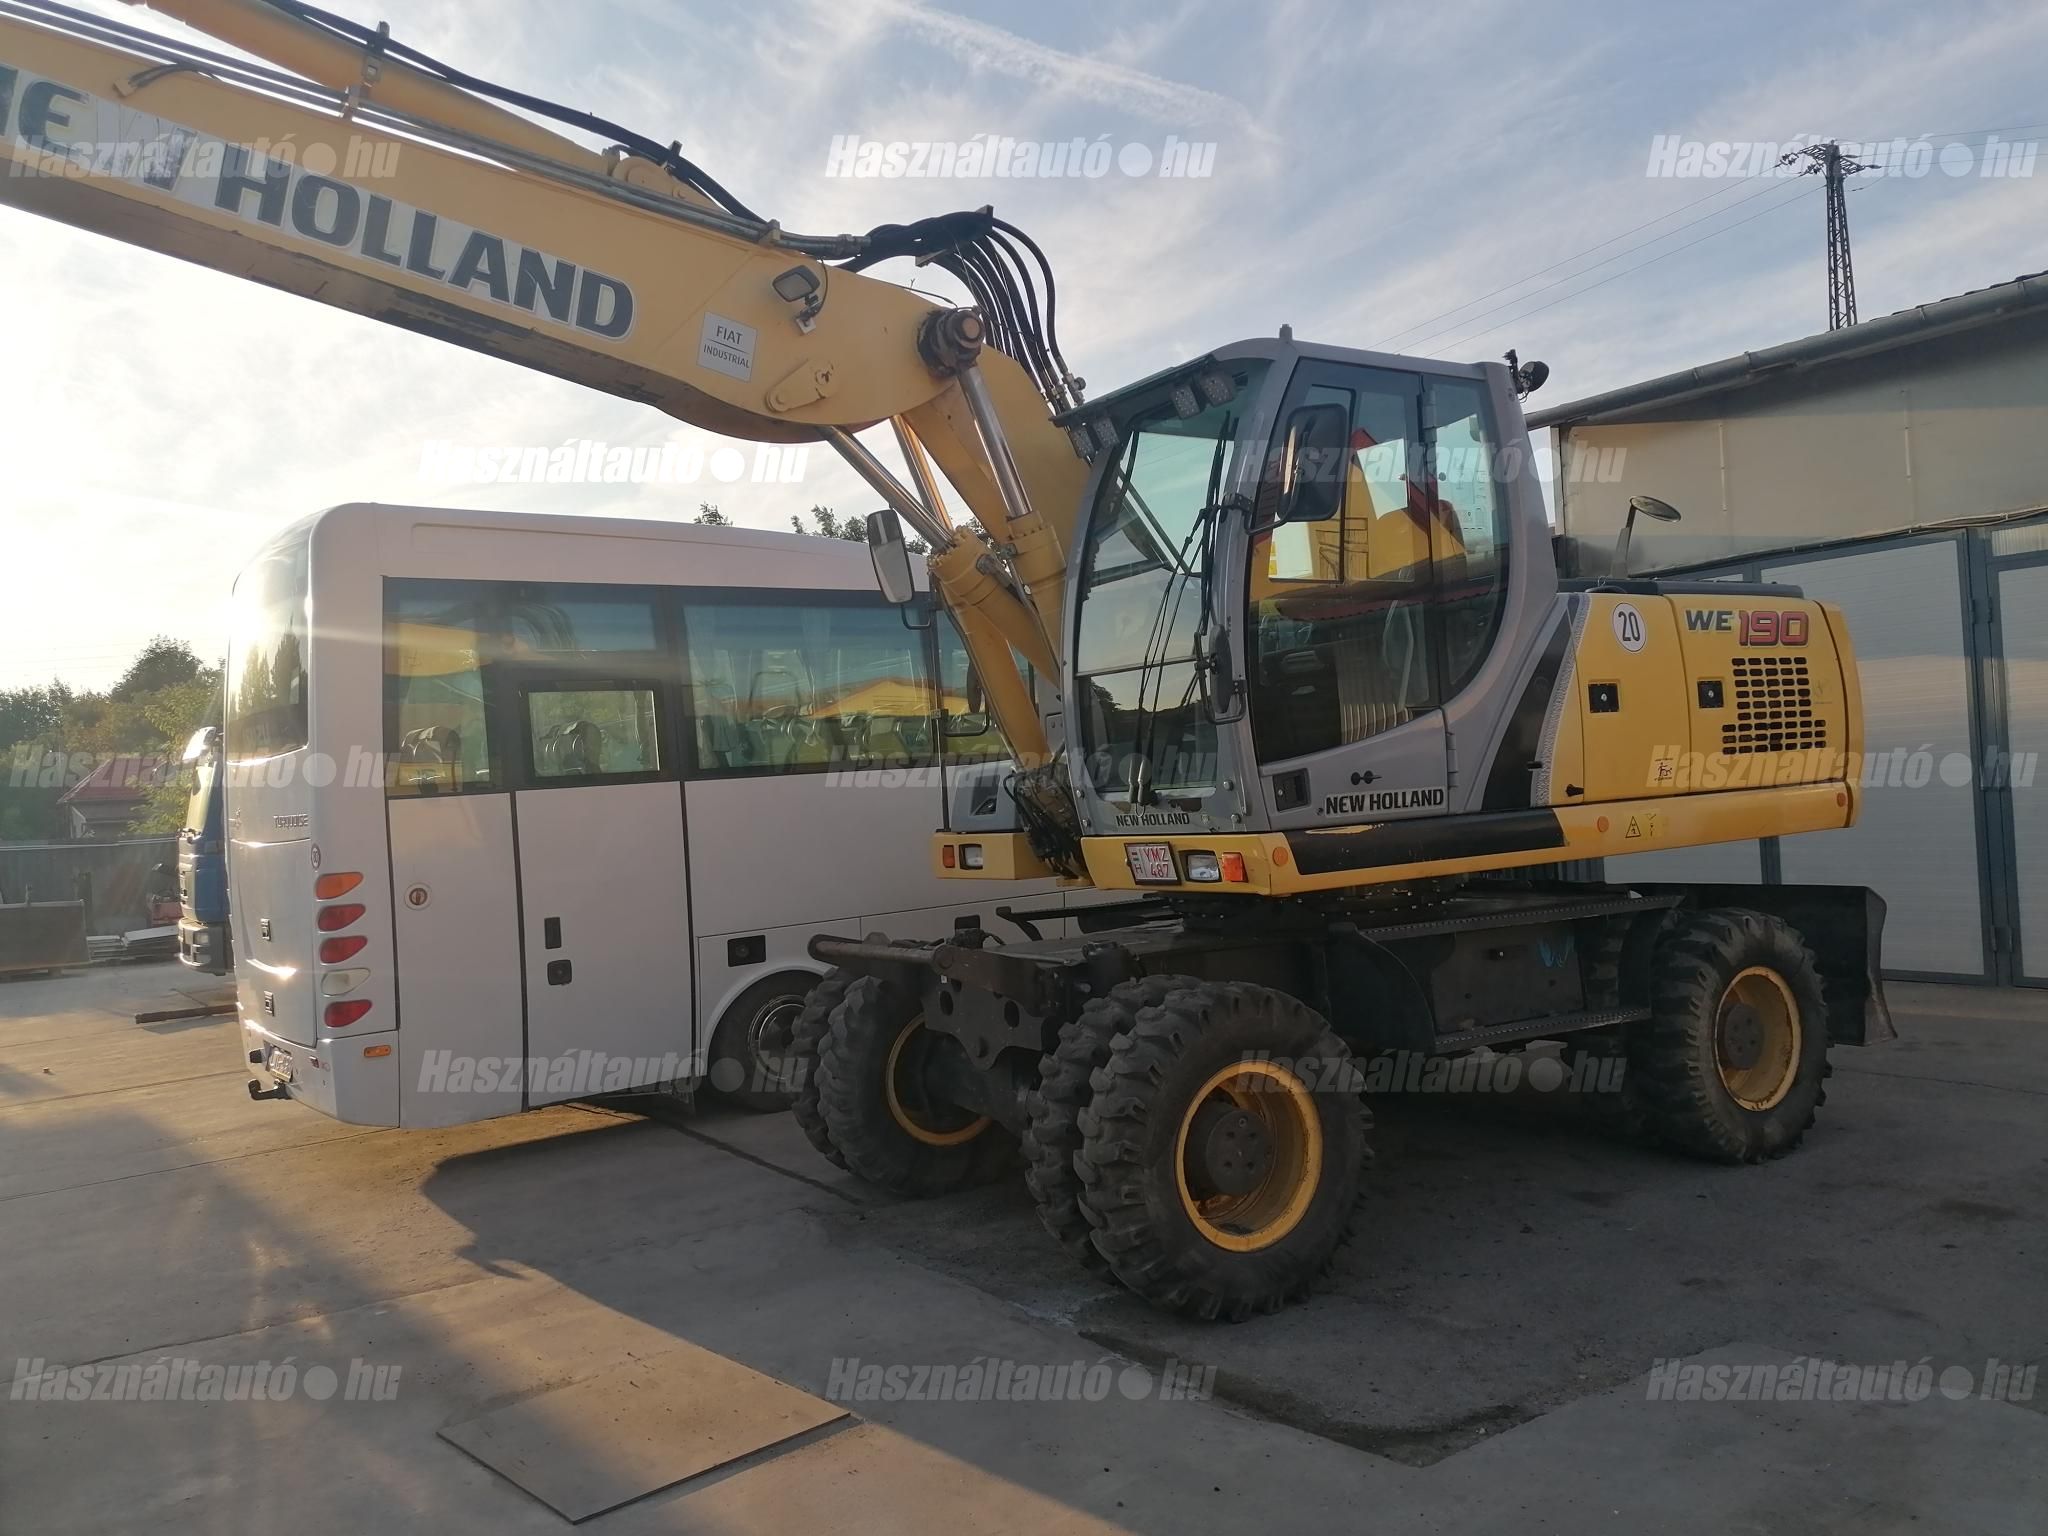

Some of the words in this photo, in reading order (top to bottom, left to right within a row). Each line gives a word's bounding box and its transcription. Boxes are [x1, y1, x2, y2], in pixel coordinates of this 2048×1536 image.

[215, 143, 634, 339] HOLLAND
[716, 325, 743, 345] FIAT
[703, 343, 750, 369] INDUSTRIAL
[1618, 611, 1641, 642] 20
[1685, 610, 1733, 631] WE
[1738, 610, 1809, 647] 190
[1326, 794, 1365, 815] NEW
[1369, 788, 1444, 811] HOLLAND
[1116, 814, 1139, 827] NEW
[1141, 812, 1190, 826] HOLLAND
[1143, 847, 1169, 862] YMZ
[1150, 863, 1169, 878] 487
